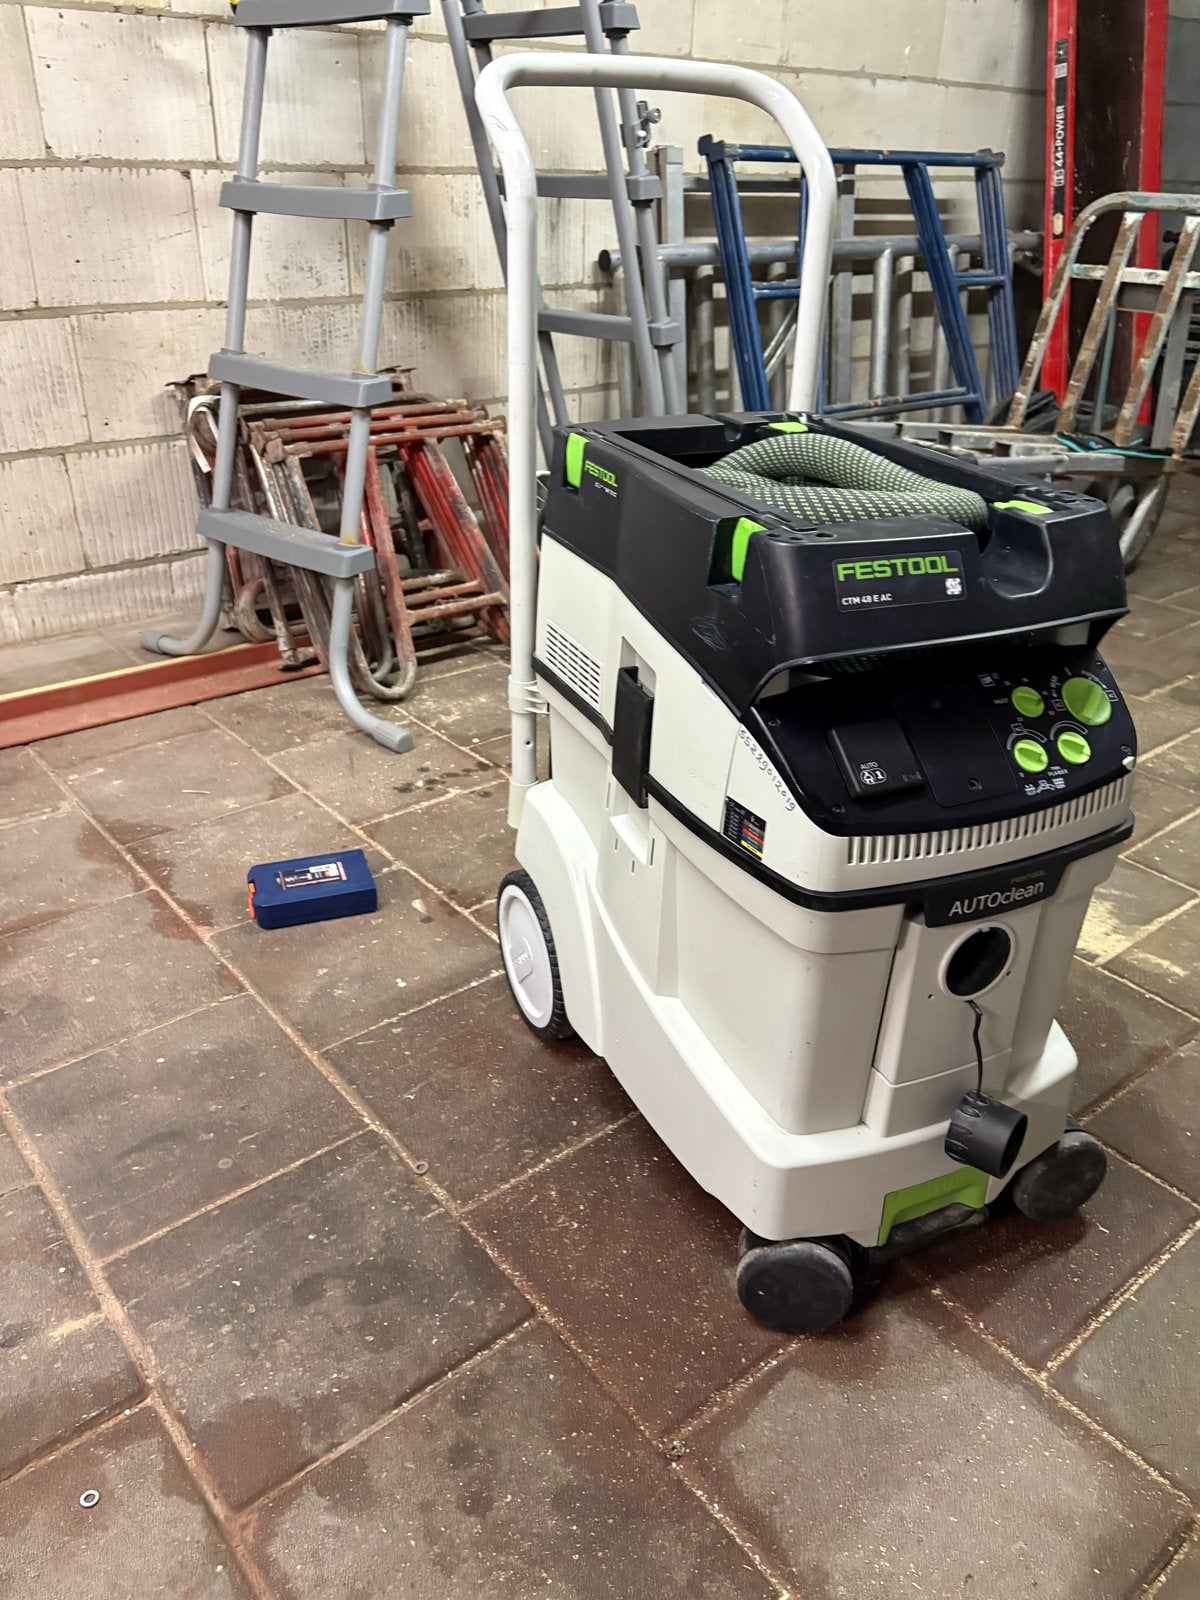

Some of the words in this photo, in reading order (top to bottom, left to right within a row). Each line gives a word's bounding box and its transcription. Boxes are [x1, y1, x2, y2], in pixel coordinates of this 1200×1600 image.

[836, 555, 959, 581] FESTOOL
[841, 596, 861, 606] CTM
[873, 594, 880, 603] E
[880, 593, 893, 602] AC
[860, 761, 879, 770] AUTO
[948, 881, 1045, 917] AUTOclean
